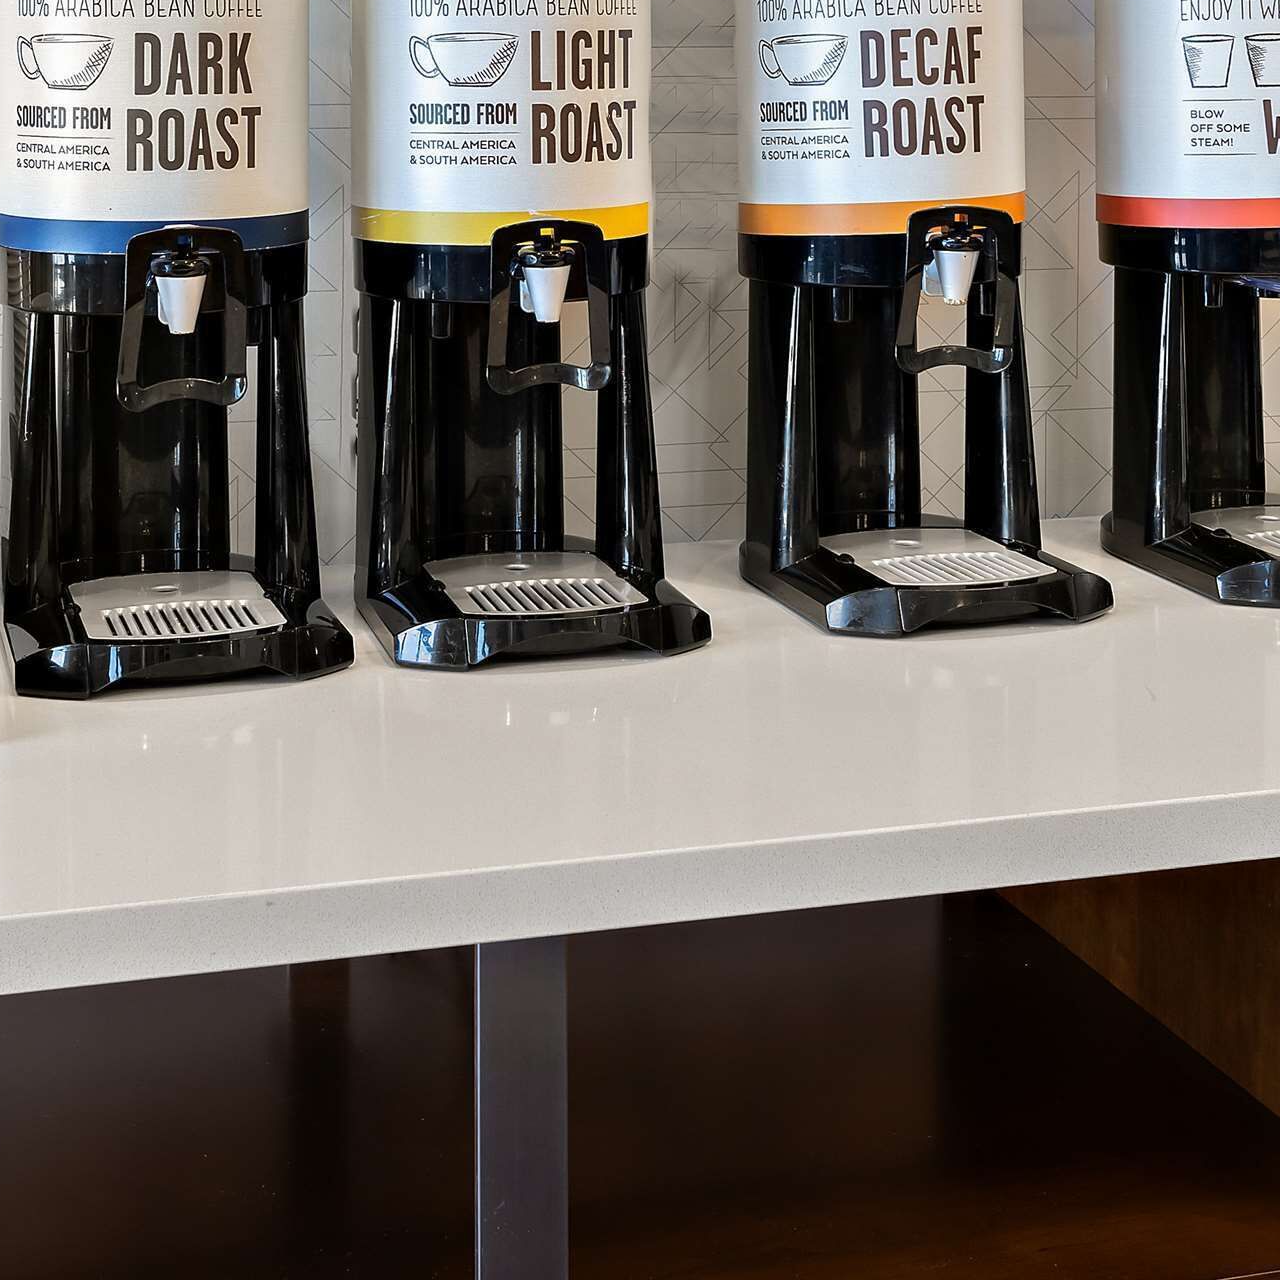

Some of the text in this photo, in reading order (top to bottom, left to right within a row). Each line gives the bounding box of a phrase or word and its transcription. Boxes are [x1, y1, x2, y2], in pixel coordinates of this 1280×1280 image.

[134, 33, 252, 95] DARK
[531, 30, 632, 91] LIGHT
[860, 26, 982, 88] DECAF
[17, 106, 111, 129] SOURCED FROM
[410, 103, 517, 125] SOURCED FROM
[760, 100, 848, 123] SOURCED FROM
[1191, 110, 1224, 119] BLOW
[531, 101, 636, 165] ROAST
[863, 95, 984, 158] ROAST
[1191, 123, 1250, 133] OFF SOME
[126, 107, 261, 171] ROAST
[410, 140, 516, 149] CENTRAL AMERICA
[761, 135, 848, 145] CENTRAL AMERICA
[1191, 137, 1233, 147] STEAM!
[16, 142, 110, 156] CENTRAL AMERICA
[762, 149, 850, 160] & SOUTH AMERICA
[16, 159, 111, 171] & SOUTH AMERICA
[410, 156, 517, 165] & SOUTH AMERICA
